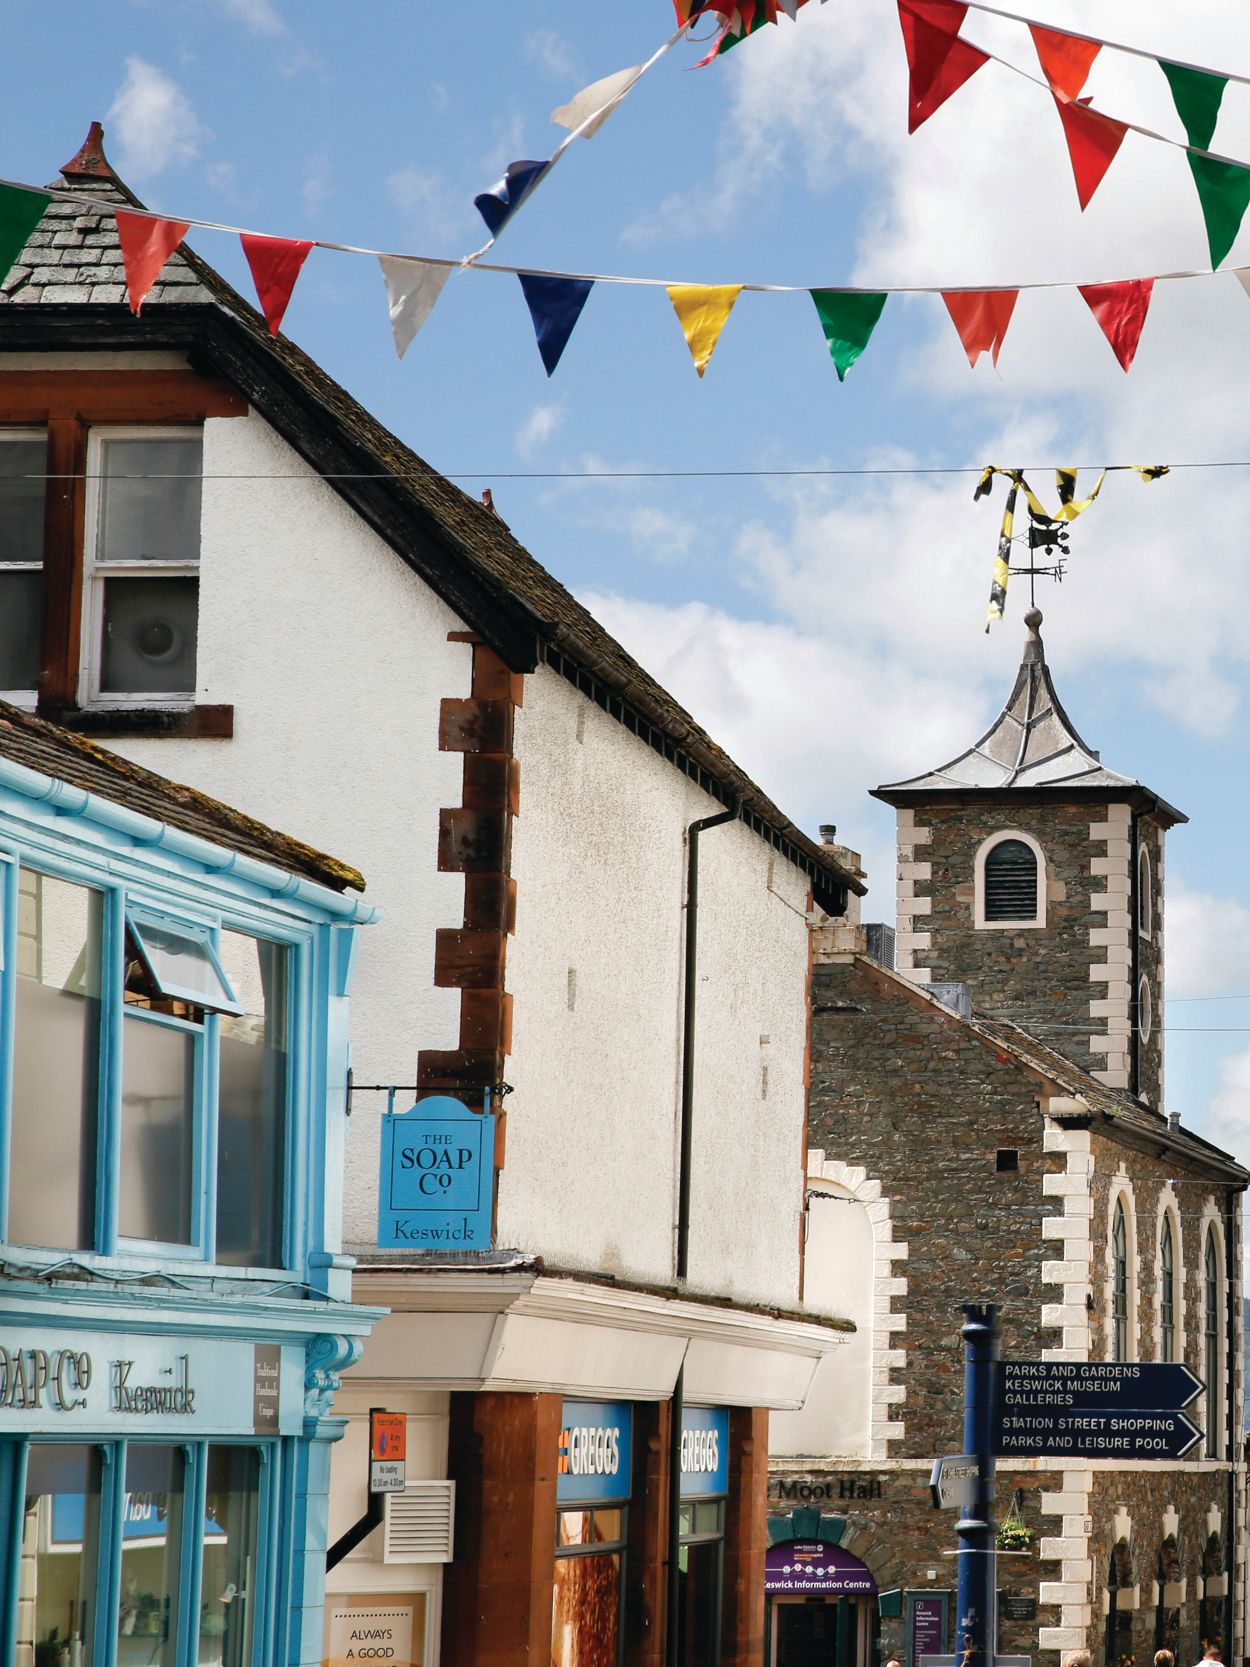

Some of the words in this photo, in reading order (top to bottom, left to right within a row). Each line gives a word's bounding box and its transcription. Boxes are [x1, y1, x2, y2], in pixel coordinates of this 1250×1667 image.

[421, 1134, 453, 1145] THE
[400, 1147, 473, 1170] SOAP
[393, 1217, 475, 1241] Keswick
[1005, 1365, 1047, 1377] PARKS
[1050, 1366, 1076, 1378] AND
[1080, 1366, 1140, 1378] GARDENS
[114, 1353, 196, 1415] Keswick
[1005, 1379, 1063, 1391] KESWICK
[1066, 1381, 1121, 1392] MUSEUM
[1005, 1393, 1074, 1405] GALLERIES
[1003, 1417, 1053, 1429] STATION
[1058, 1418, 1106, 1430] STREET
[1110, 1419, 1175, 1431] SHOPPING
[1002, 1436, 1043, 1447] PARKS
[1047, 1436, 1073, 1448] AND
[1078, 1437, 1131, 1449] LEISURE
[1135, 1438, 1169, 1449] POOL
[570, 1427, 620, 1475] GREGGS
[681, 1430, 719, 1473] GREGGS
[778, 1479, 833, 1499] Moot
[838, 1479, 882, 1499] Hall
[764, 1580, 793, 1589] eswick
[794, 1580, 842, 1589] Information
[843, 1580, 871, 1589] Centre
[350, 1628, 393, 1640] ALWAYS
[345, 1648, 355, 1659] A
[357, 1647, 395, 1659] GOOD
